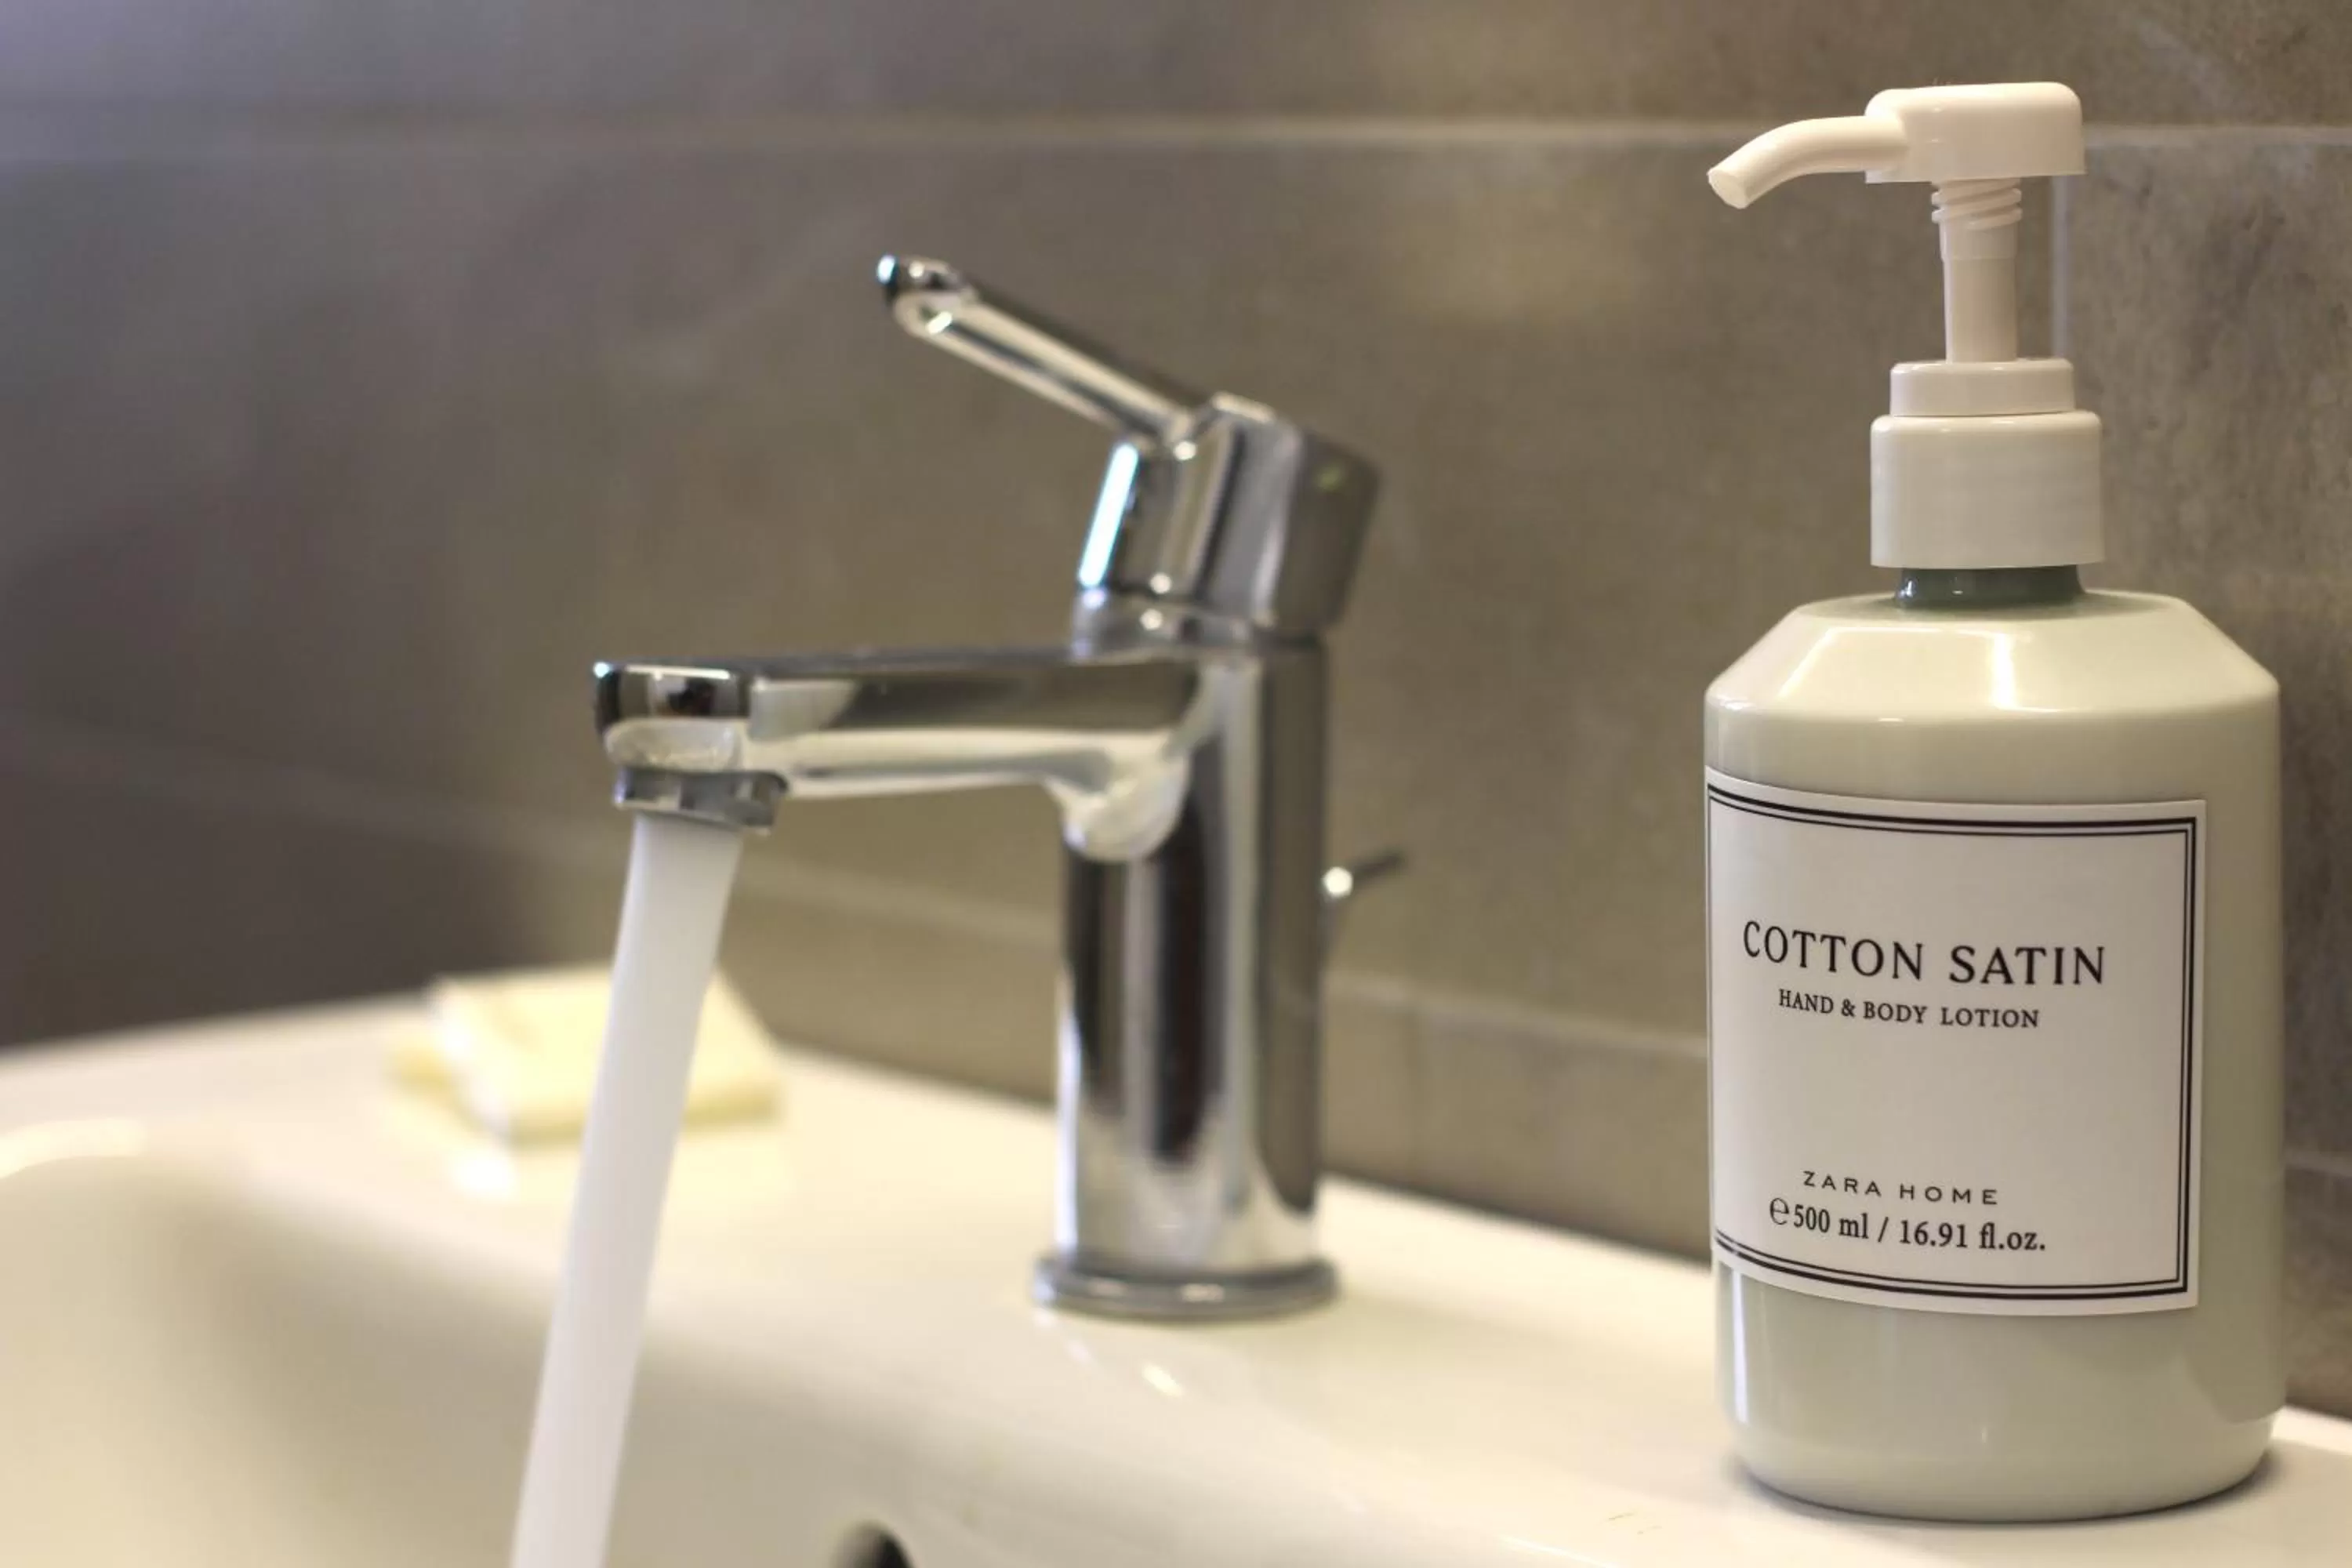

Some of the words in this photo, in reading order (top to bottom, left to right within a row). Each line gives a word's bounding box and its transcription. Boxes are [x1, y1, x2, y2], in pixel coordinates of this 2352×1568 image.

[1742, 920, 1924, 982] COTTON
[1947, 945, 2106, 986] SATIN
[1778, 988, 1835, 1015] HAND
[1840, 998, 1857, 1018] &
[1862, 1000, 1928, 1025] BODY
[1940, 1007, 2040, 1029] LOTION
[1802, 1171, 1882, 1198] ZARA
[1898, 1183, 1998, 1206] HOME
[1838, 1212, 1871, 1240] ml
[1877, 1216, 1890, 1243] /
[1899, 1219, 1969, 1249] 16.91
[1978, 1221, 2046, 1252] fl.oz.
